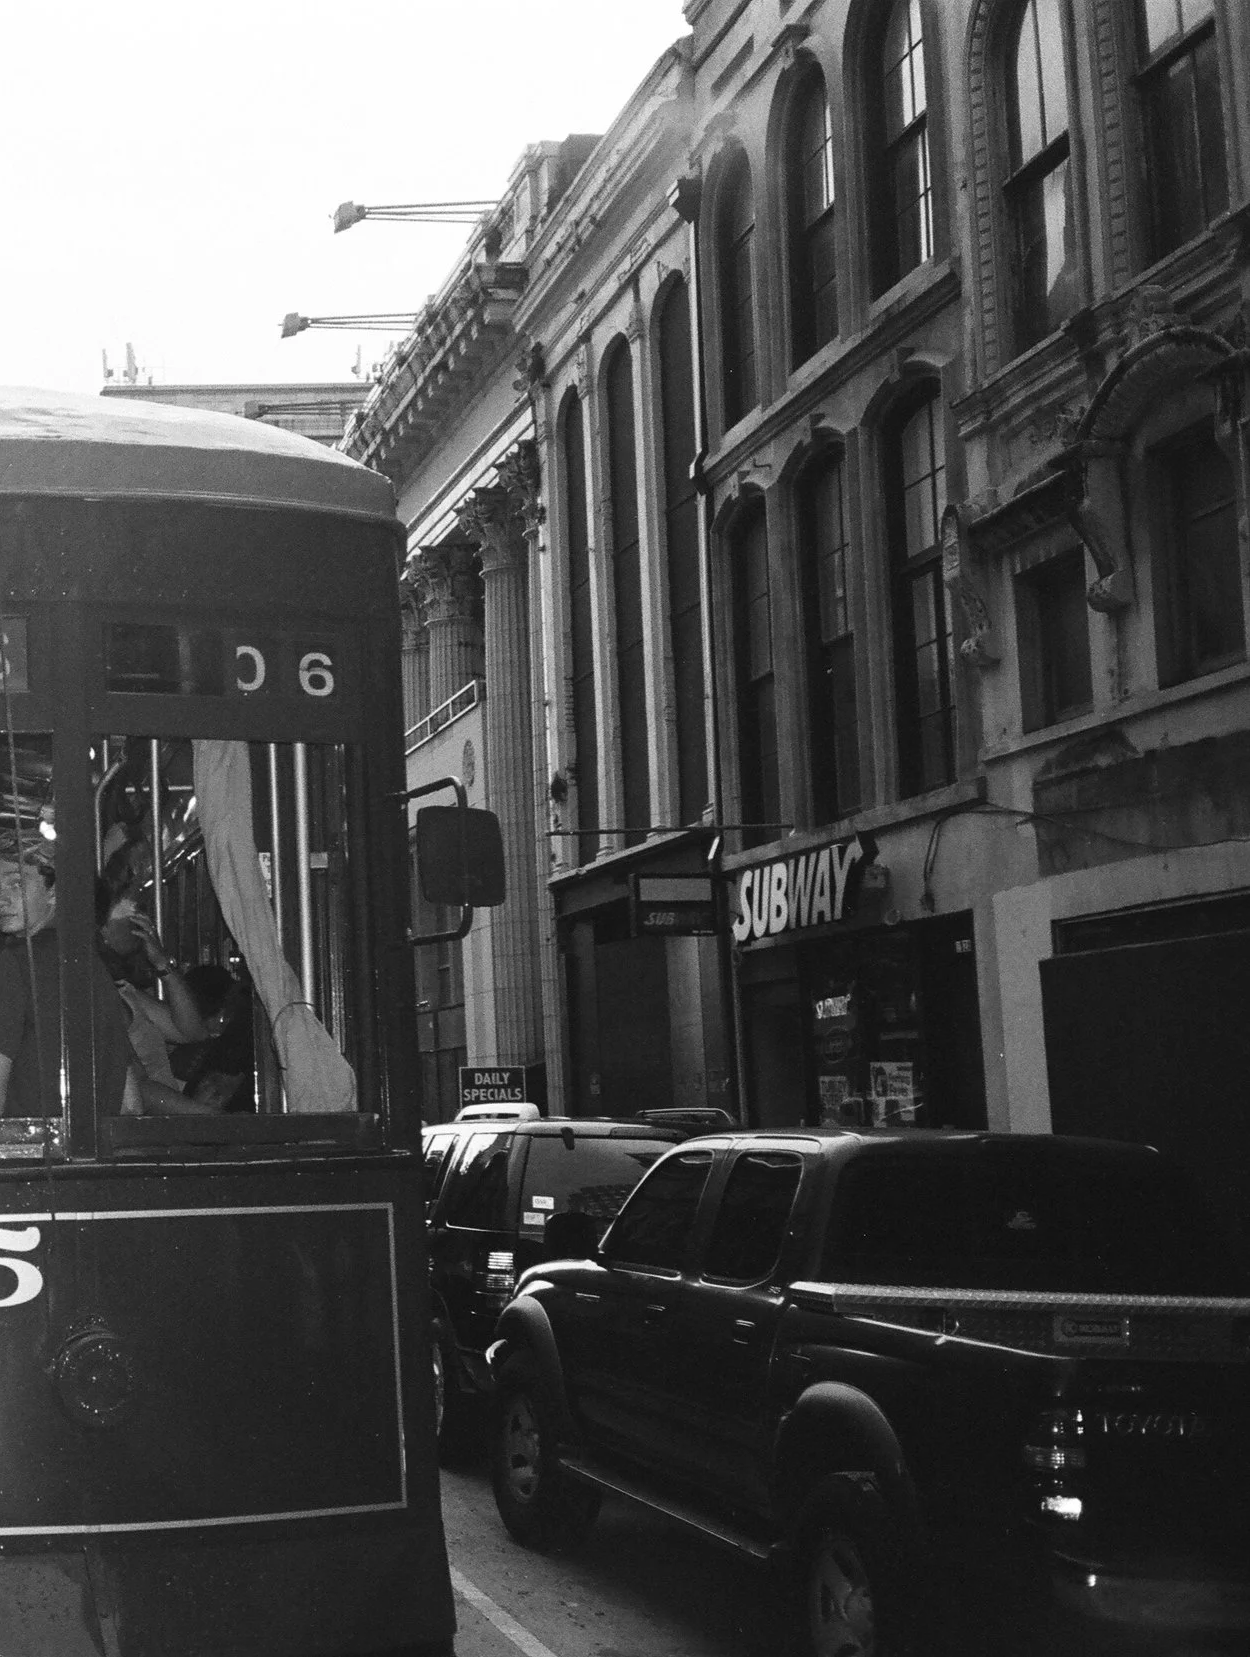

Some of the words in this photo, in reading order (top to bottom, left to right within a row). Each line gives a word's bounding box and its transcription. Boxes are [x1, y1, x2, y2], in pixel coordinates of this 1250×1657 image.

[732, 837, 863, 942] SUBWAY
[474, 1072, 510, 1085] DAILY
[463, 1088, 523, 1101] SPECIALS
